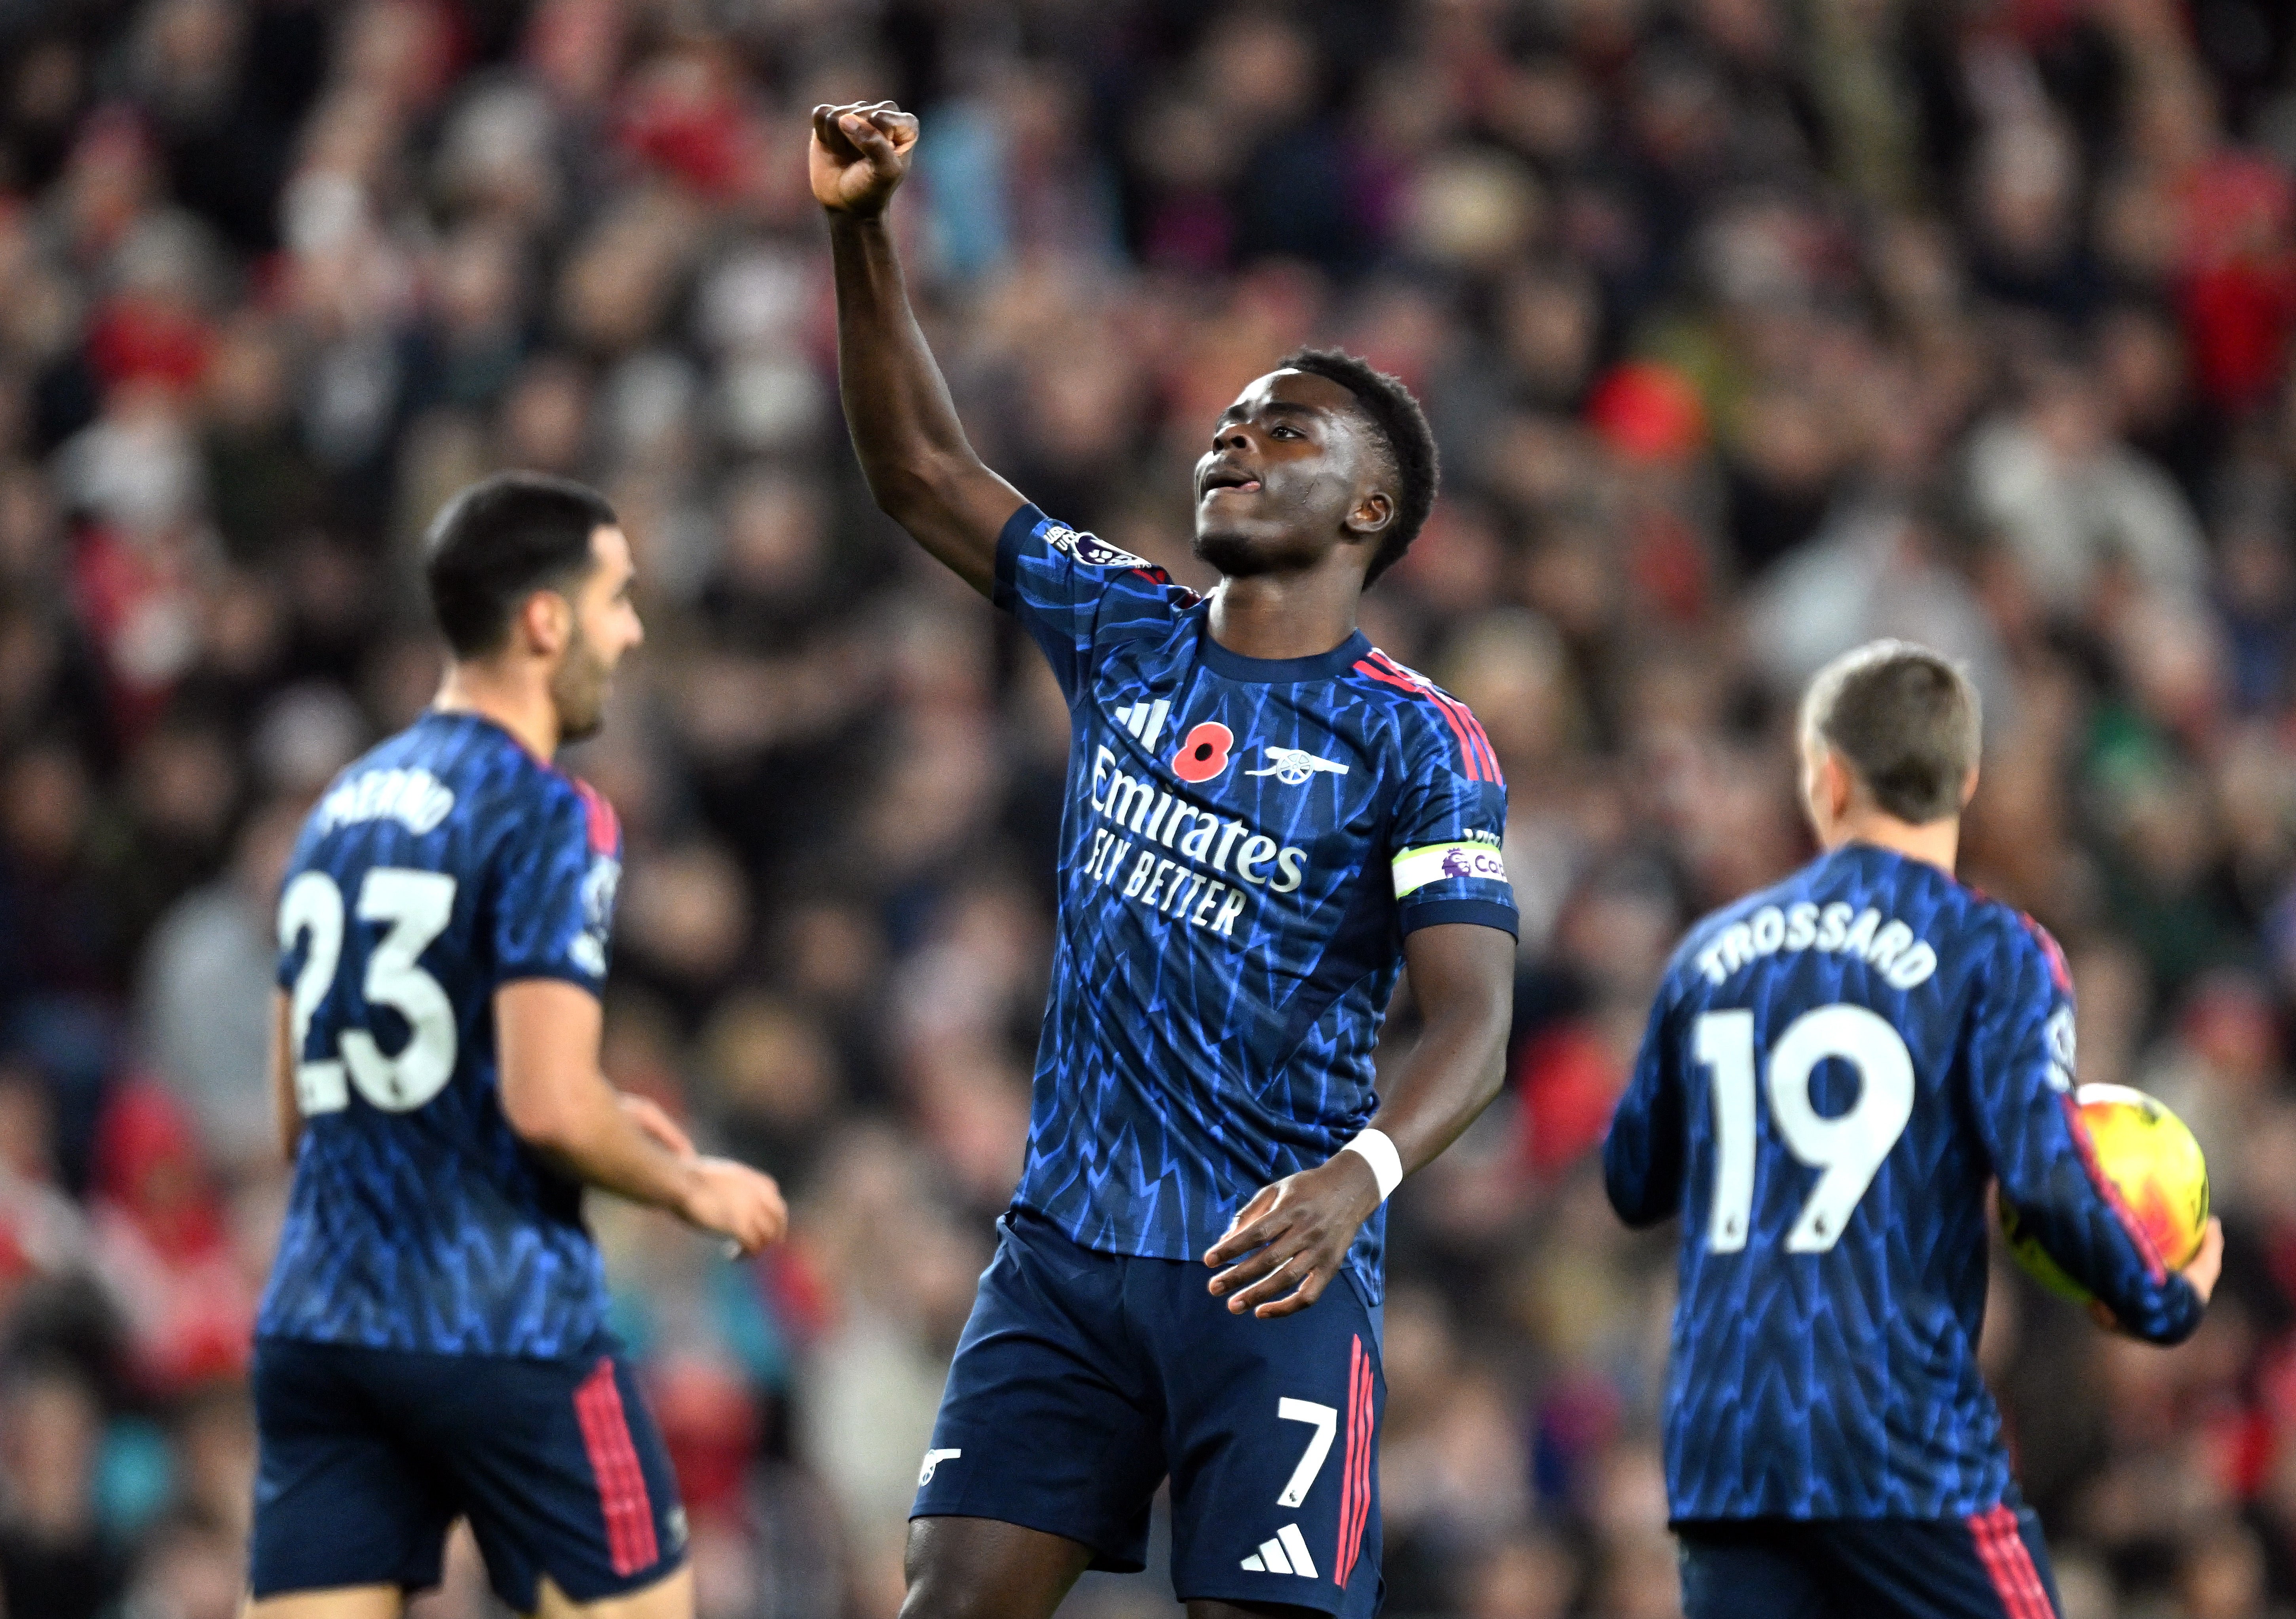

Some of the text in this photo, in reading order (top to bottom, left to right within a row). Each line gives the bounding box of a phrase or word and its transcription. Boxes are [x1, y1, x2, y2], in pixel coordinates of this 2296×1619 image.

[1084, 828, 1247, 936] FLY BETTER
[1091, 744, 1307, 893] Emirates
[278, 868, 457, 1117] 23
[1697, 901, 1937, 990] TROSSARD
[1696, 1003, 1916, 1253] 19
[1277, 1397, 1338, 1508] 7
